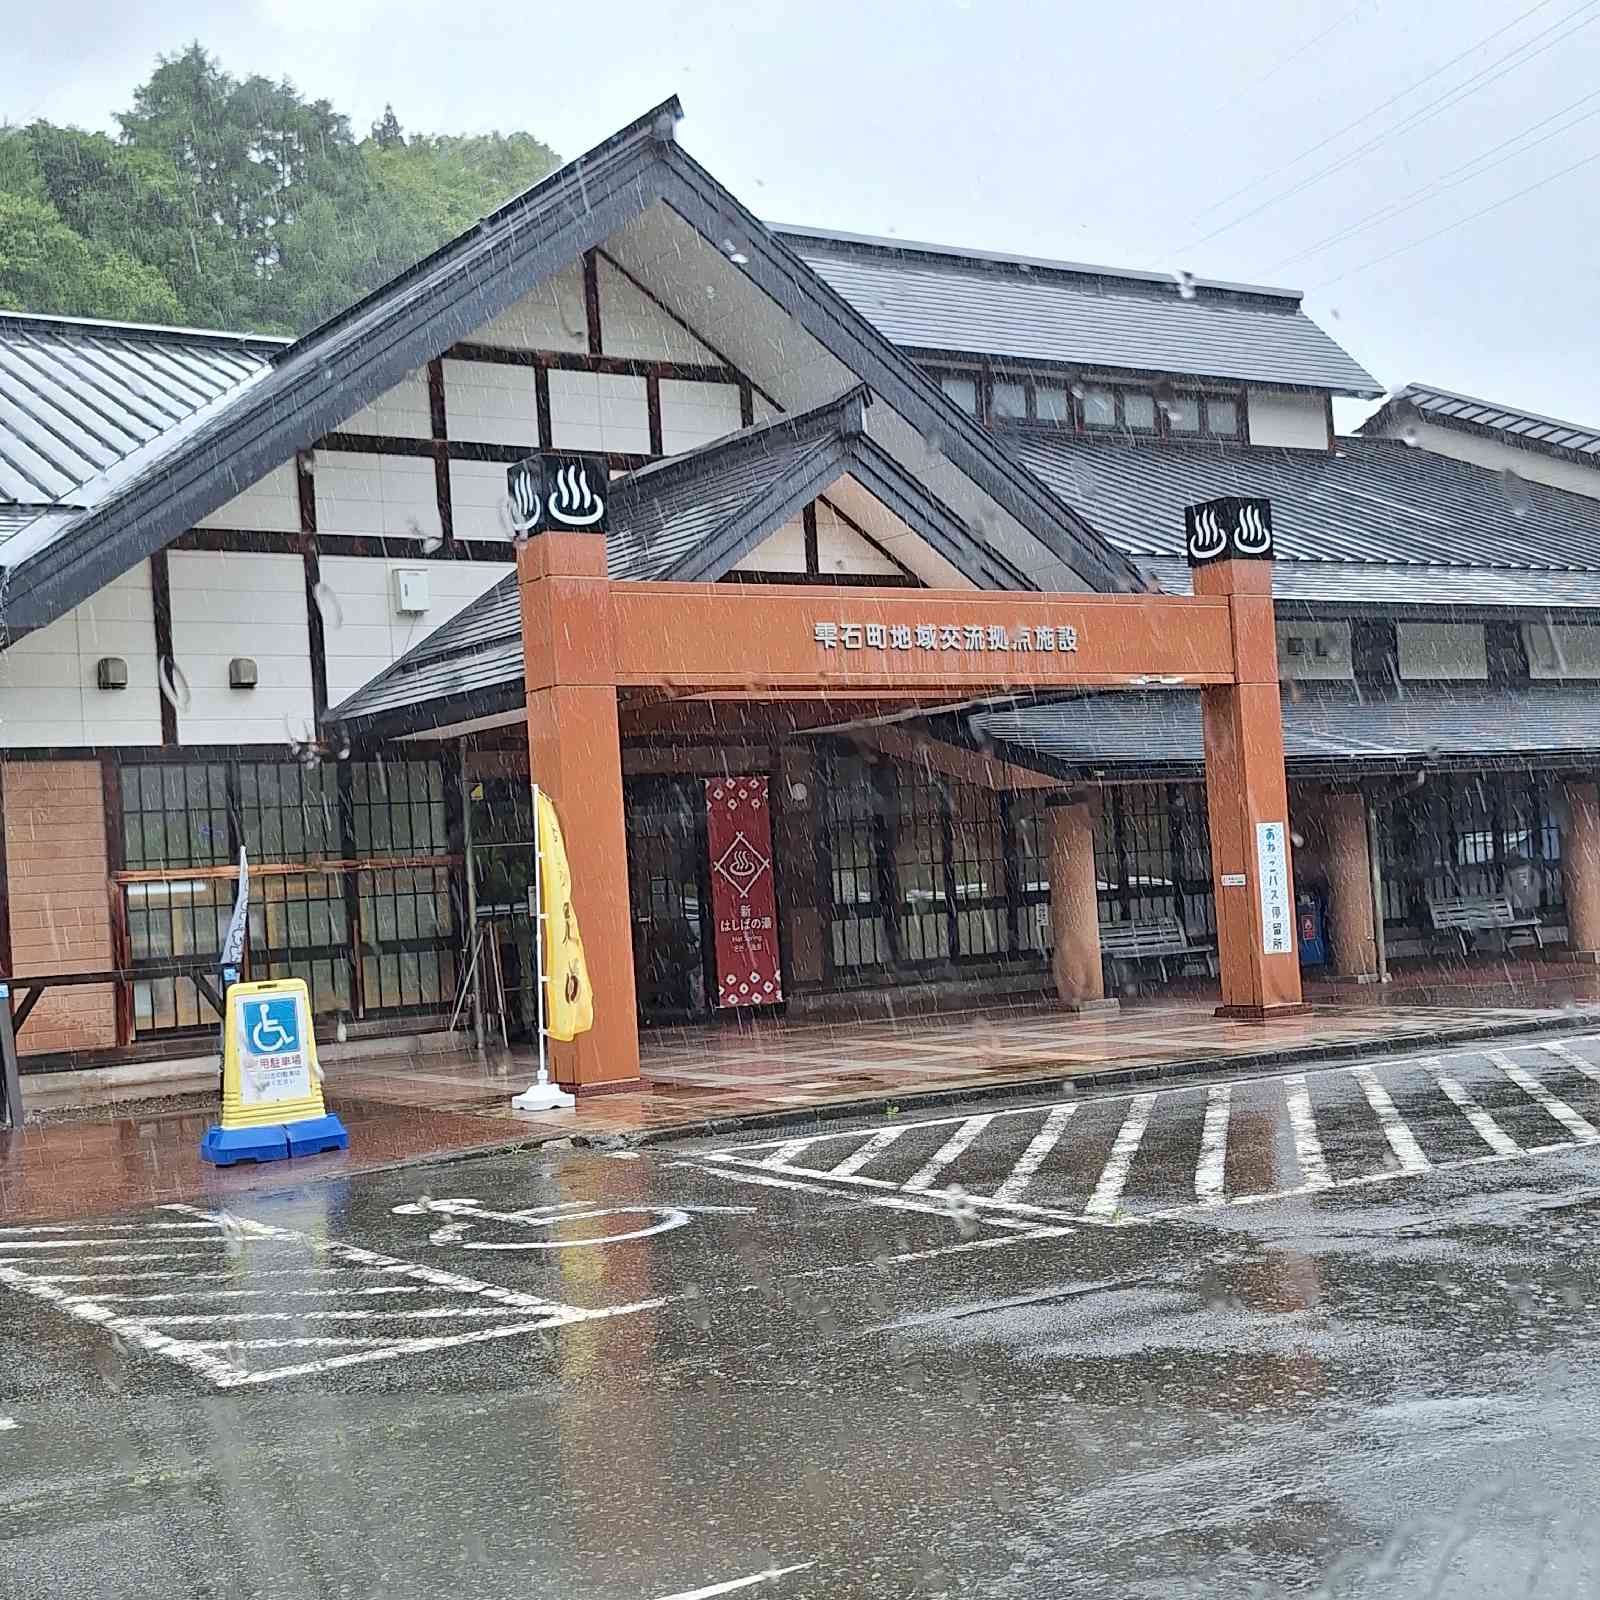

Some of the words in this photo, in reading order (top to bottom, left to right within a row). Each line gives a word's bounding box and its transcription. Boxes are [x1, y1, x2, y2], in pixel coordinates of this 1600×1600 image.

[814, 622, 1079, 652] 雫石町地域交流拠点施設
[740, 904, 751, 918] 新
